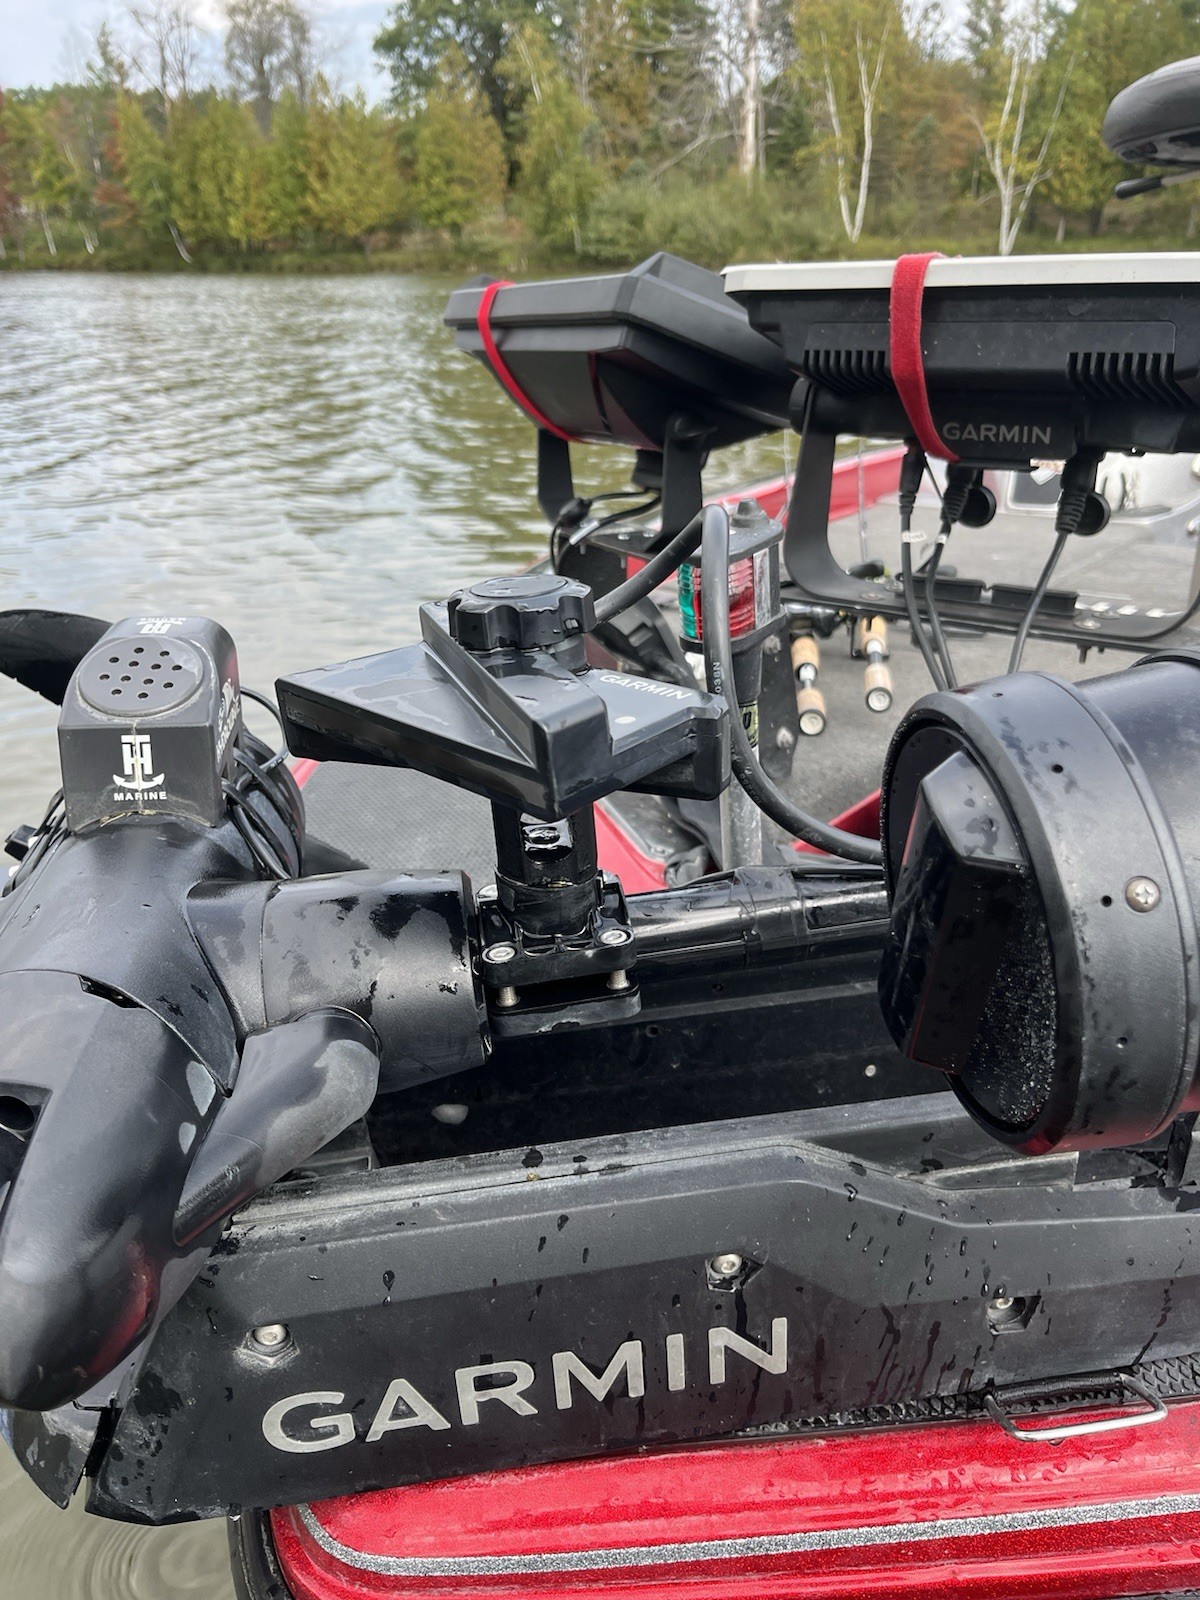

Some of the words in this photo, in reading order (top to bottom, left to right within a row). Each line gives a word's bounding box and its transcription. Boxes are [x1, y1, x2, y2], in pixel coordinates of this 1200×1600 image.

[942, 422, 1051, 445] GARMIN
[599, 674, 692, 700] GARMIN
[113, 791, 168, 802] MARINE
[261, 1317, 788, 1454] GARMIN
